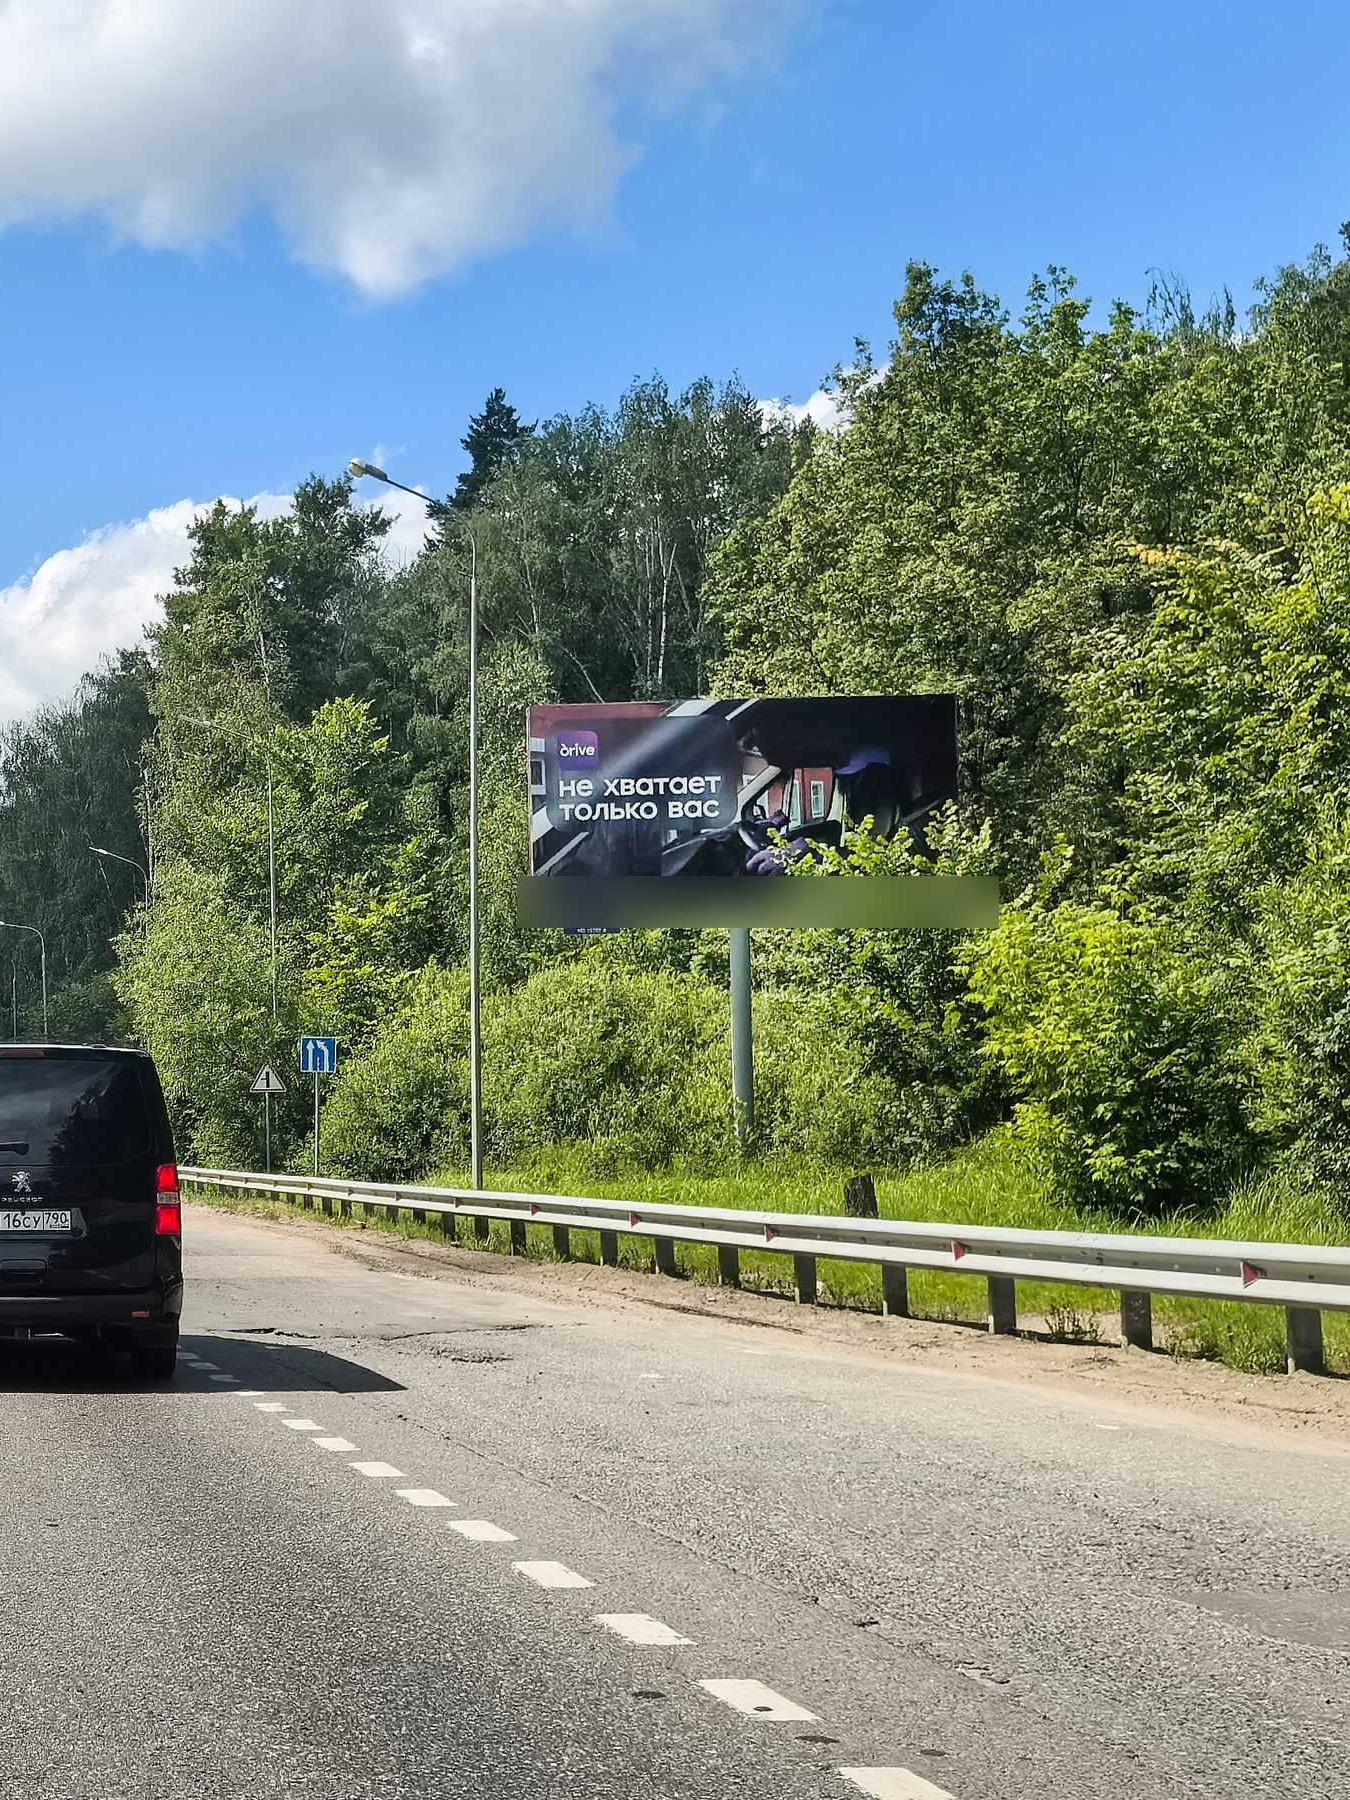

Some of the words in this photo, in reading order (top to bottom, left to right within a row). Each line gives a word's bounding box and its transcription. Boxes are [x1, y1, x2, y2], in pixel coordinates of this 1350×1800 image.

[558, 778, 594, 798] не
[603, 775, 722, 797] хватает
[558, 801, 658, 821] только
[668, 799, 720, 819] вас
